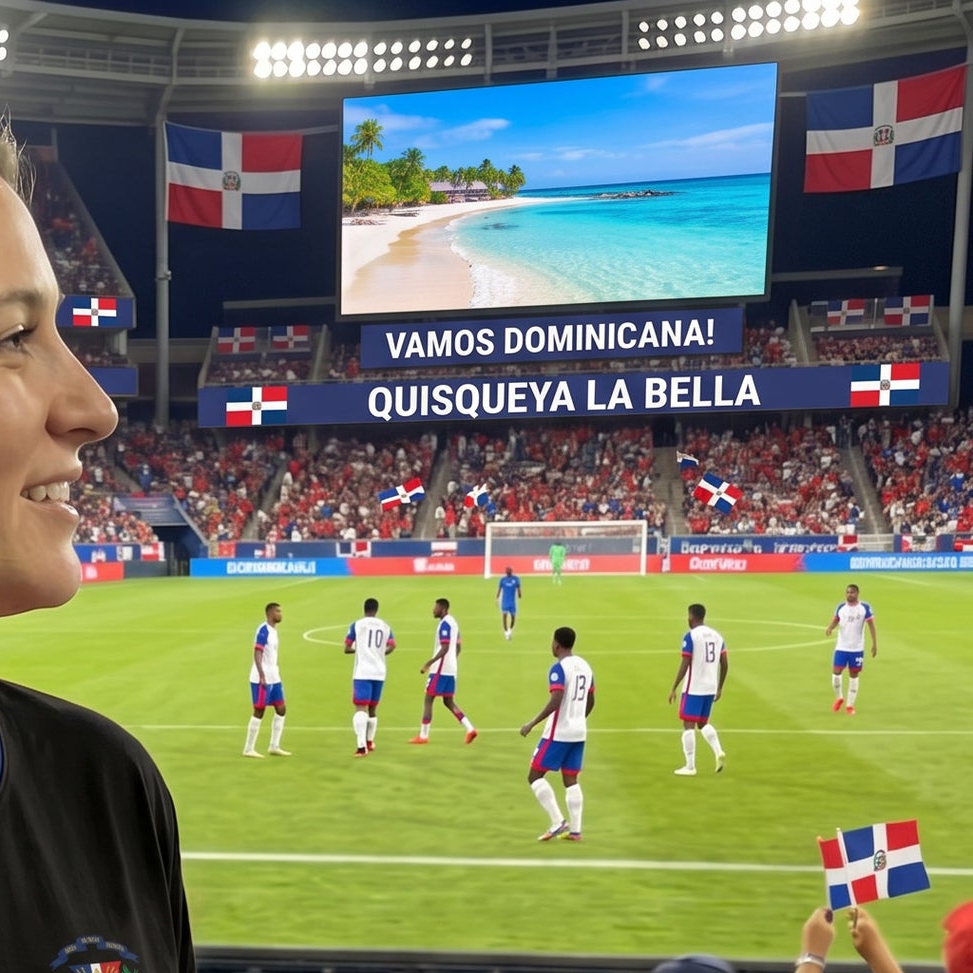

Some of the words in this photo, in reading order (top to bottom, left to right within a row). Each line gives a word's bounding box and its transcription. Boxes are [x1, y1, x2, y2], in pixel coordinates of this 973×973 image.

[385, 328, 495, 359] VAMOS
[504, 318, 715, 354] DOMINICANA!
[368, 380, 576, 422] QUISQUEYA
[587, 378, 634, 411] LA
[645, 374, 761, 409] BELLA
[368, 629, 384, 648] 10
[705, 641, 716, 663] 13
